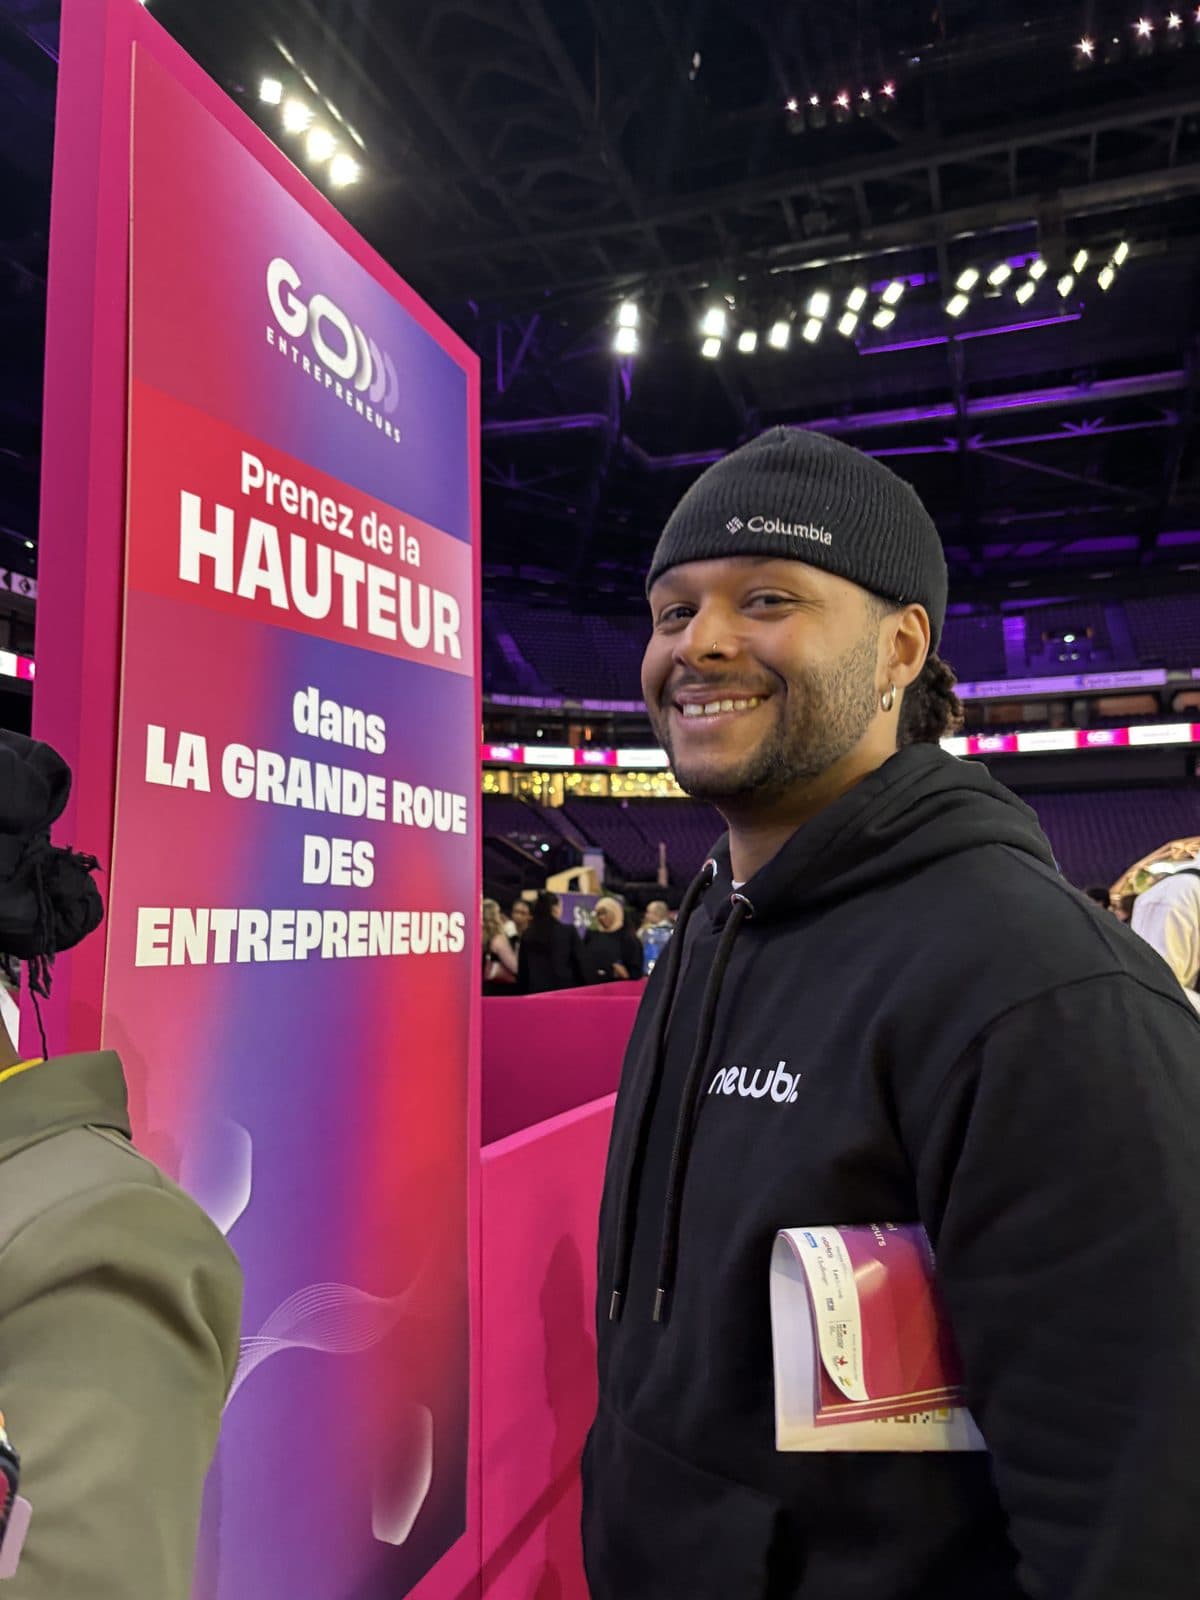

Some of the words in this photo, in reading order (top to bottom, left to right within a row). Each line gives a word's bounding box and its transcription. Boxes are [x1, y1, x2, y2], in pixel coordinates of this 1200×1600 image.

[266, 325, 401, 443] ENTREPRENEURS
[241, 450, 354, 539] Prenez
[360, 510, 393, 555] de
[399, 524, 421, 567] la
[747, 515, 833, 546] Columbia
[179, 489, 462, 660] HAUTEUR
[293, 686, 386, 755] dans
[145, 724, 211, 793] LA
[221, 743, 386, 822] GRANDE
[392, 779, 467, 835] ROUE
[303, 834, 375, 888] DES
[135, 907, 465, 967] ENTREPRENEURS
